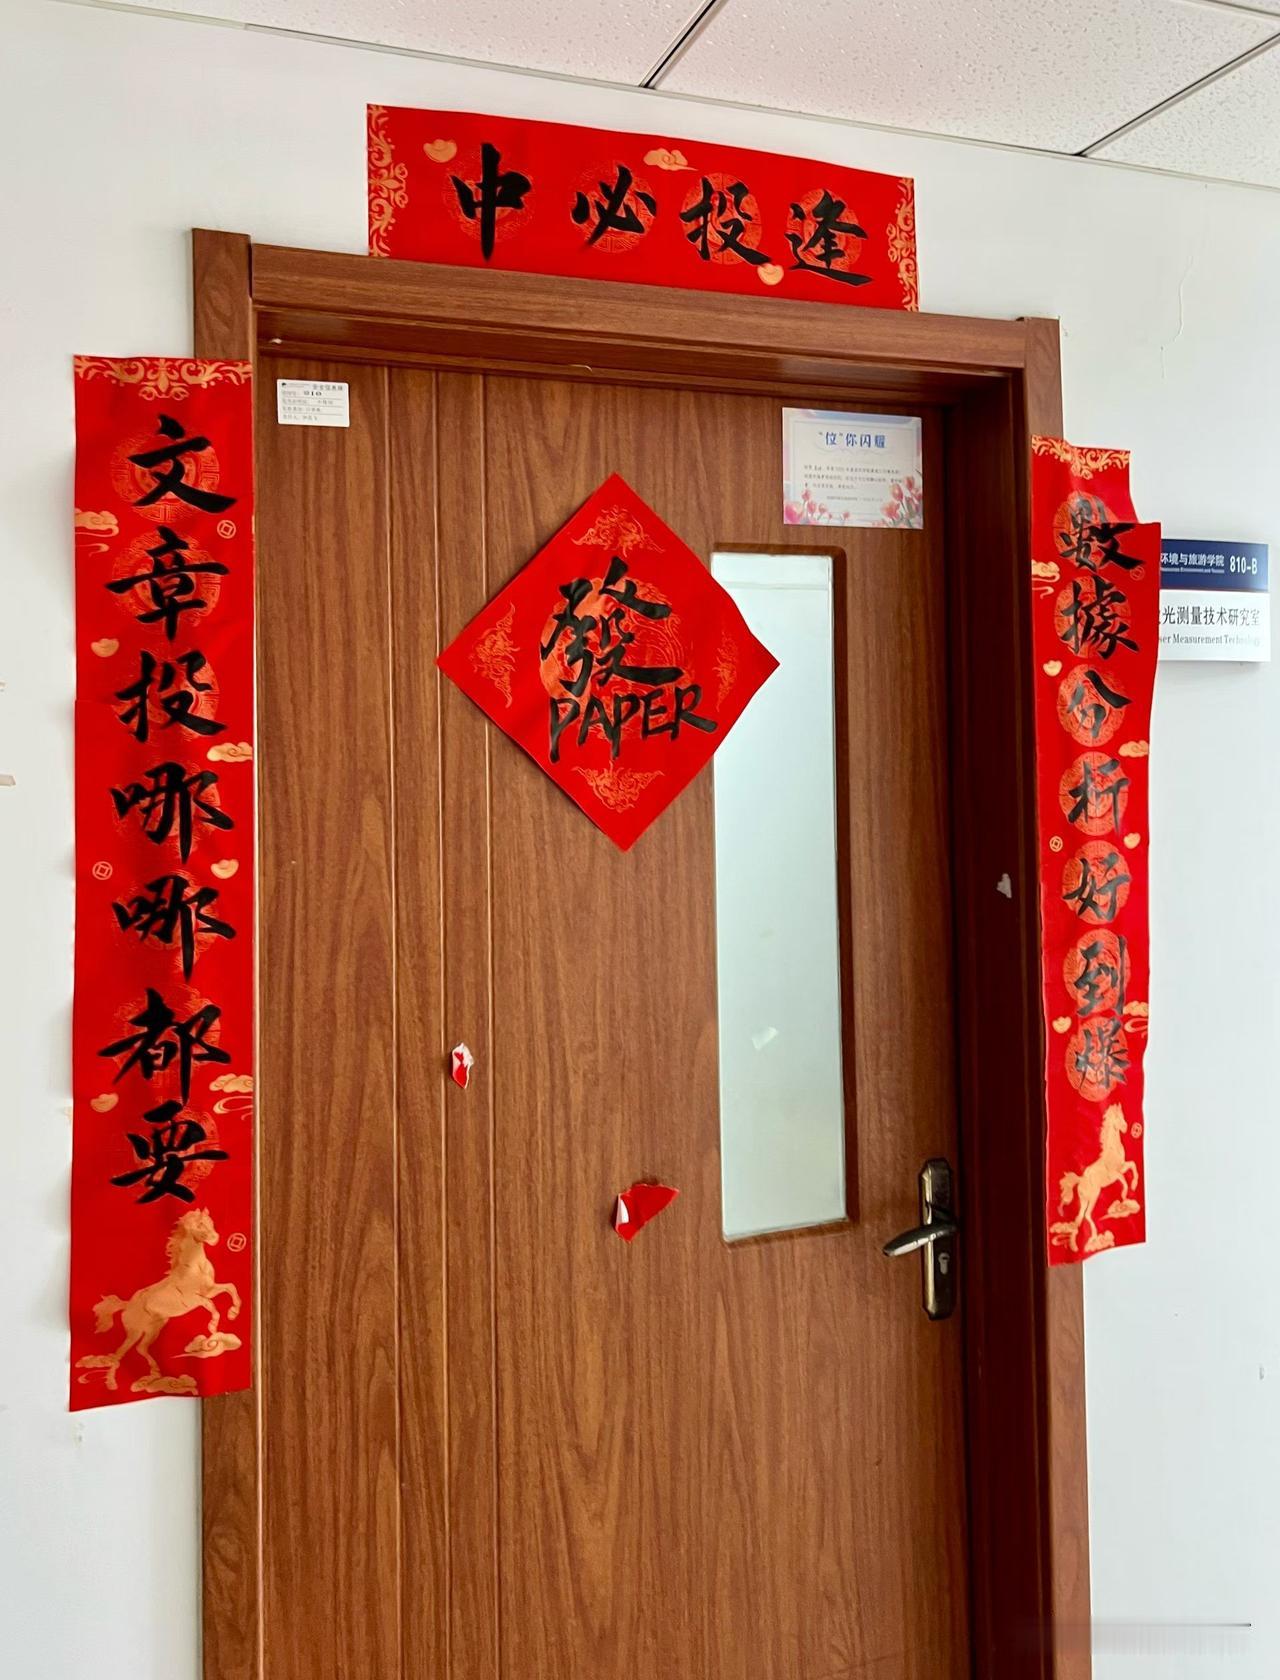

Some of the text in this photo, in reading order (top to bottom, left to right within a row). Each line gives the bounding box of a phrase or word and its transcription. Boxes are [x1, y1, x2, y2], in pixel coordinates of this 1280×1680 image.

[1229, 555, 1258, 575] 810-B
[1159, 605, 1260, 627] 光测量技术研究室
[1172, 633, 1223, 645] Measurement
[549, 684, 719, 764] PAPER
[99, 413, 238, 1205] 文章投哪哪都要
